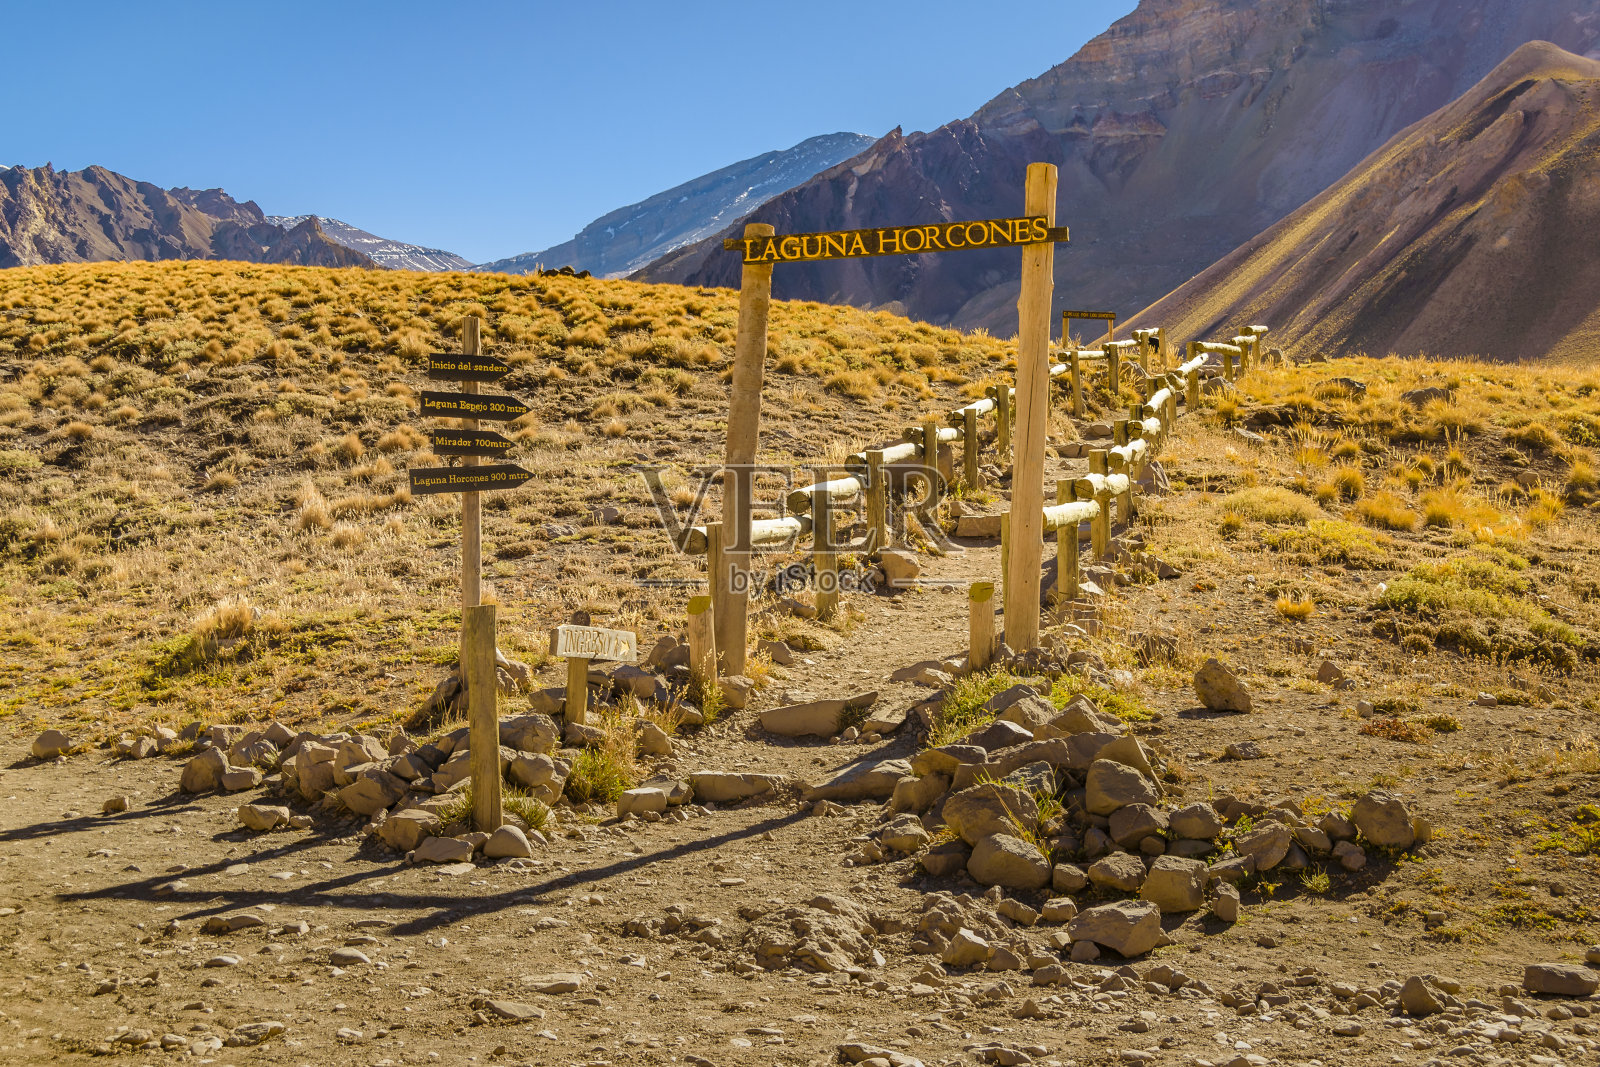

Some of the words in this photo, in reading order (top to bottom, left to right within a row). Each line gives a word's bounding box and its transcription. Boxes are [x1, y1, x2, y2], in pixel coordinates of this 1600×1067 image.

[743, 232, 870, 263] LAGUNA
[877, 216, 1049, 254] HORCONES
[430, 360, 456, 371] Inicio
[458, 361, 471, 371] del
[473, 362, 508, 373] sendero
[424, 397, 458, 411] Laguna
[459, 400, 488, 413] Espejo
[489, 402, 506, 412] 300
[506, 404, 528, 413] mtrs
[435, 436, 472, 447] Mirador
[475, 438, 512, 448] 700mtrs
[414, 475, 447, 487] Laguna
[448, 474, 489, 484] Horcones
[490, 472, 507, 481] 900
[508, 471, 529, 480] mtrs
